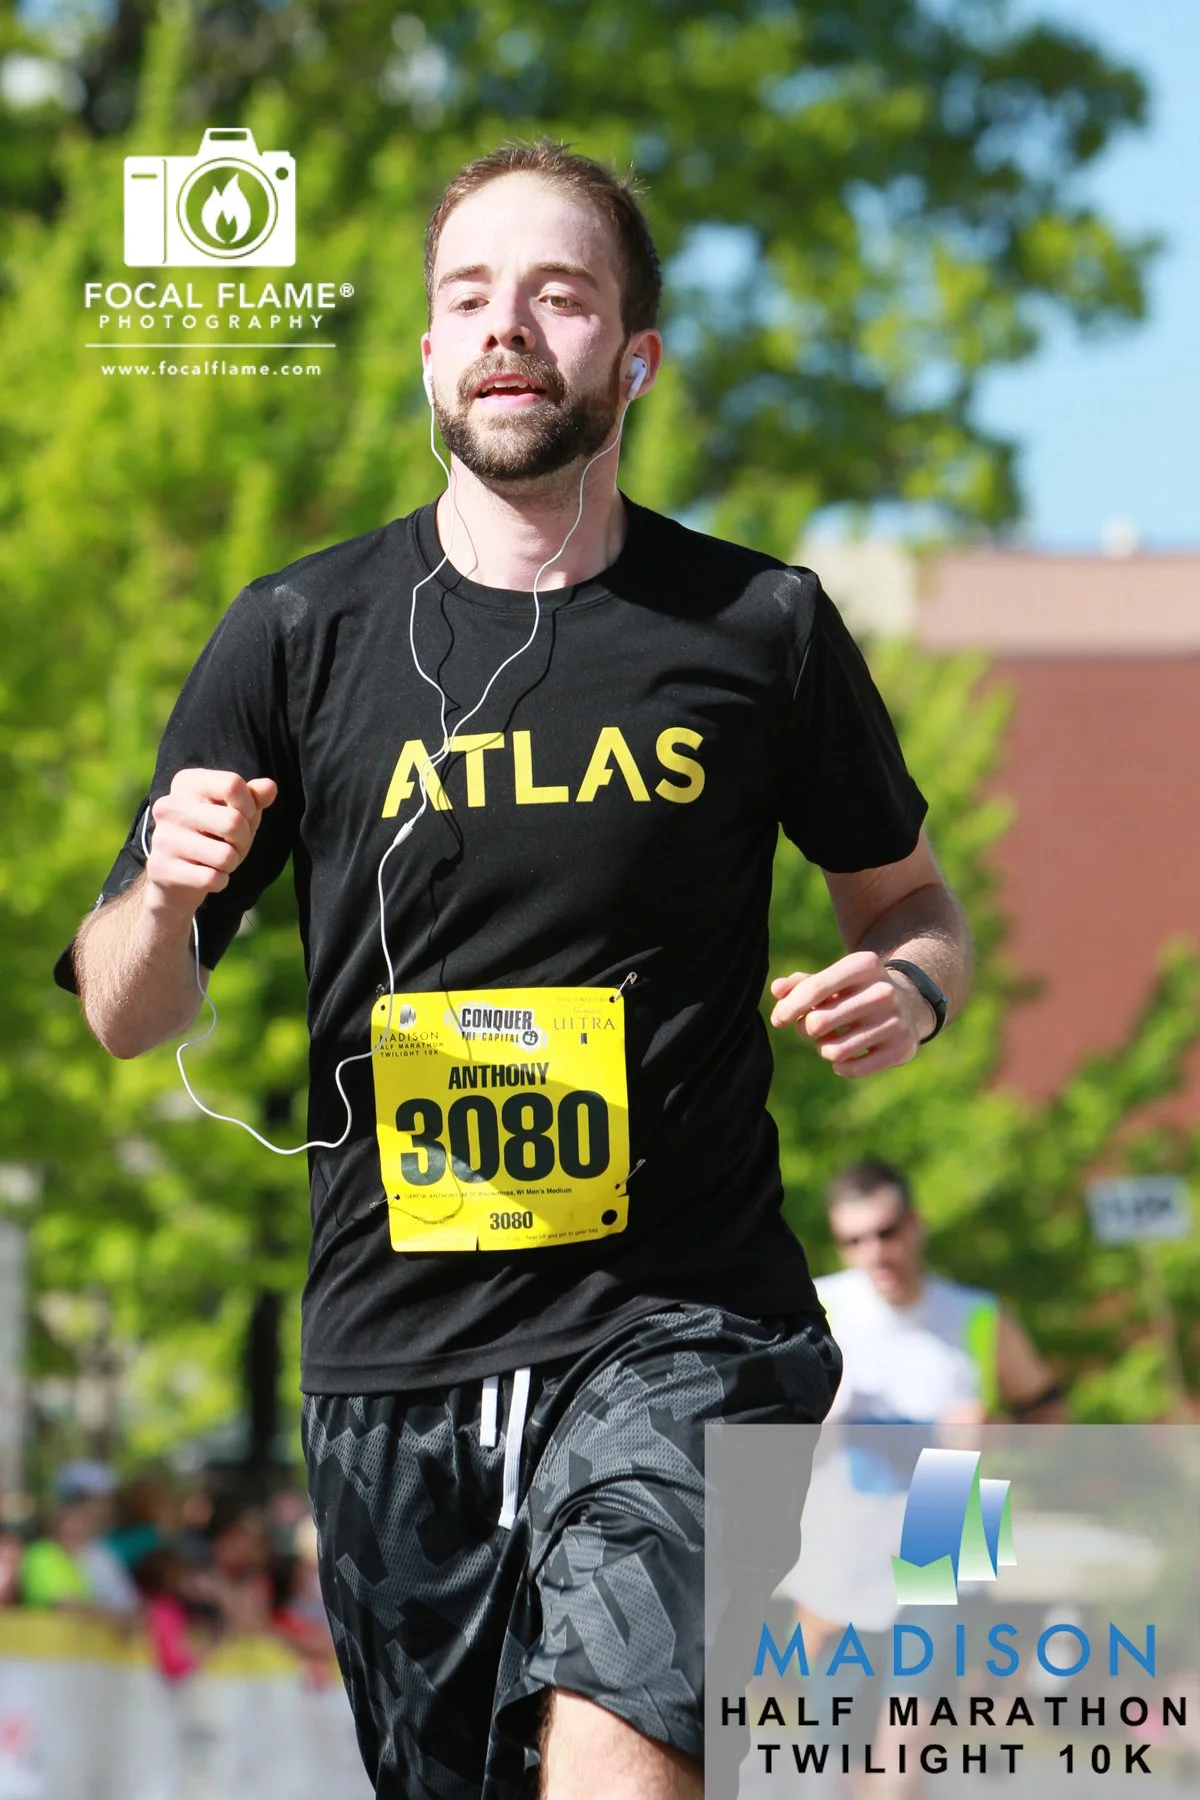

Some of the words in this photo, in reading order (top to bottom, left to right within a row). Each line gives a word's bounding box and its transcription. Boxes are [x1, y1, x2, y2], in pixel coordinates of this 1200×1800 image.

[381, 726, 706, 819] ATLAS
[461, 1008, 533, 1031] CONQUER
[398, 1042, 444, 1050] MARATHON
[461, 1031, 476, 1041] THE
[482, 1032, 520, 1043] CAPITAL
[380, 1050, 420, 1058] TWILIGHT
[448, 1062, 550, 1090] ANTHONY
[395, 1090, 610, 1187] 3080
[526, 1187, 545, 1195] Men's
[490, 1210, 534, 1230] 3080
